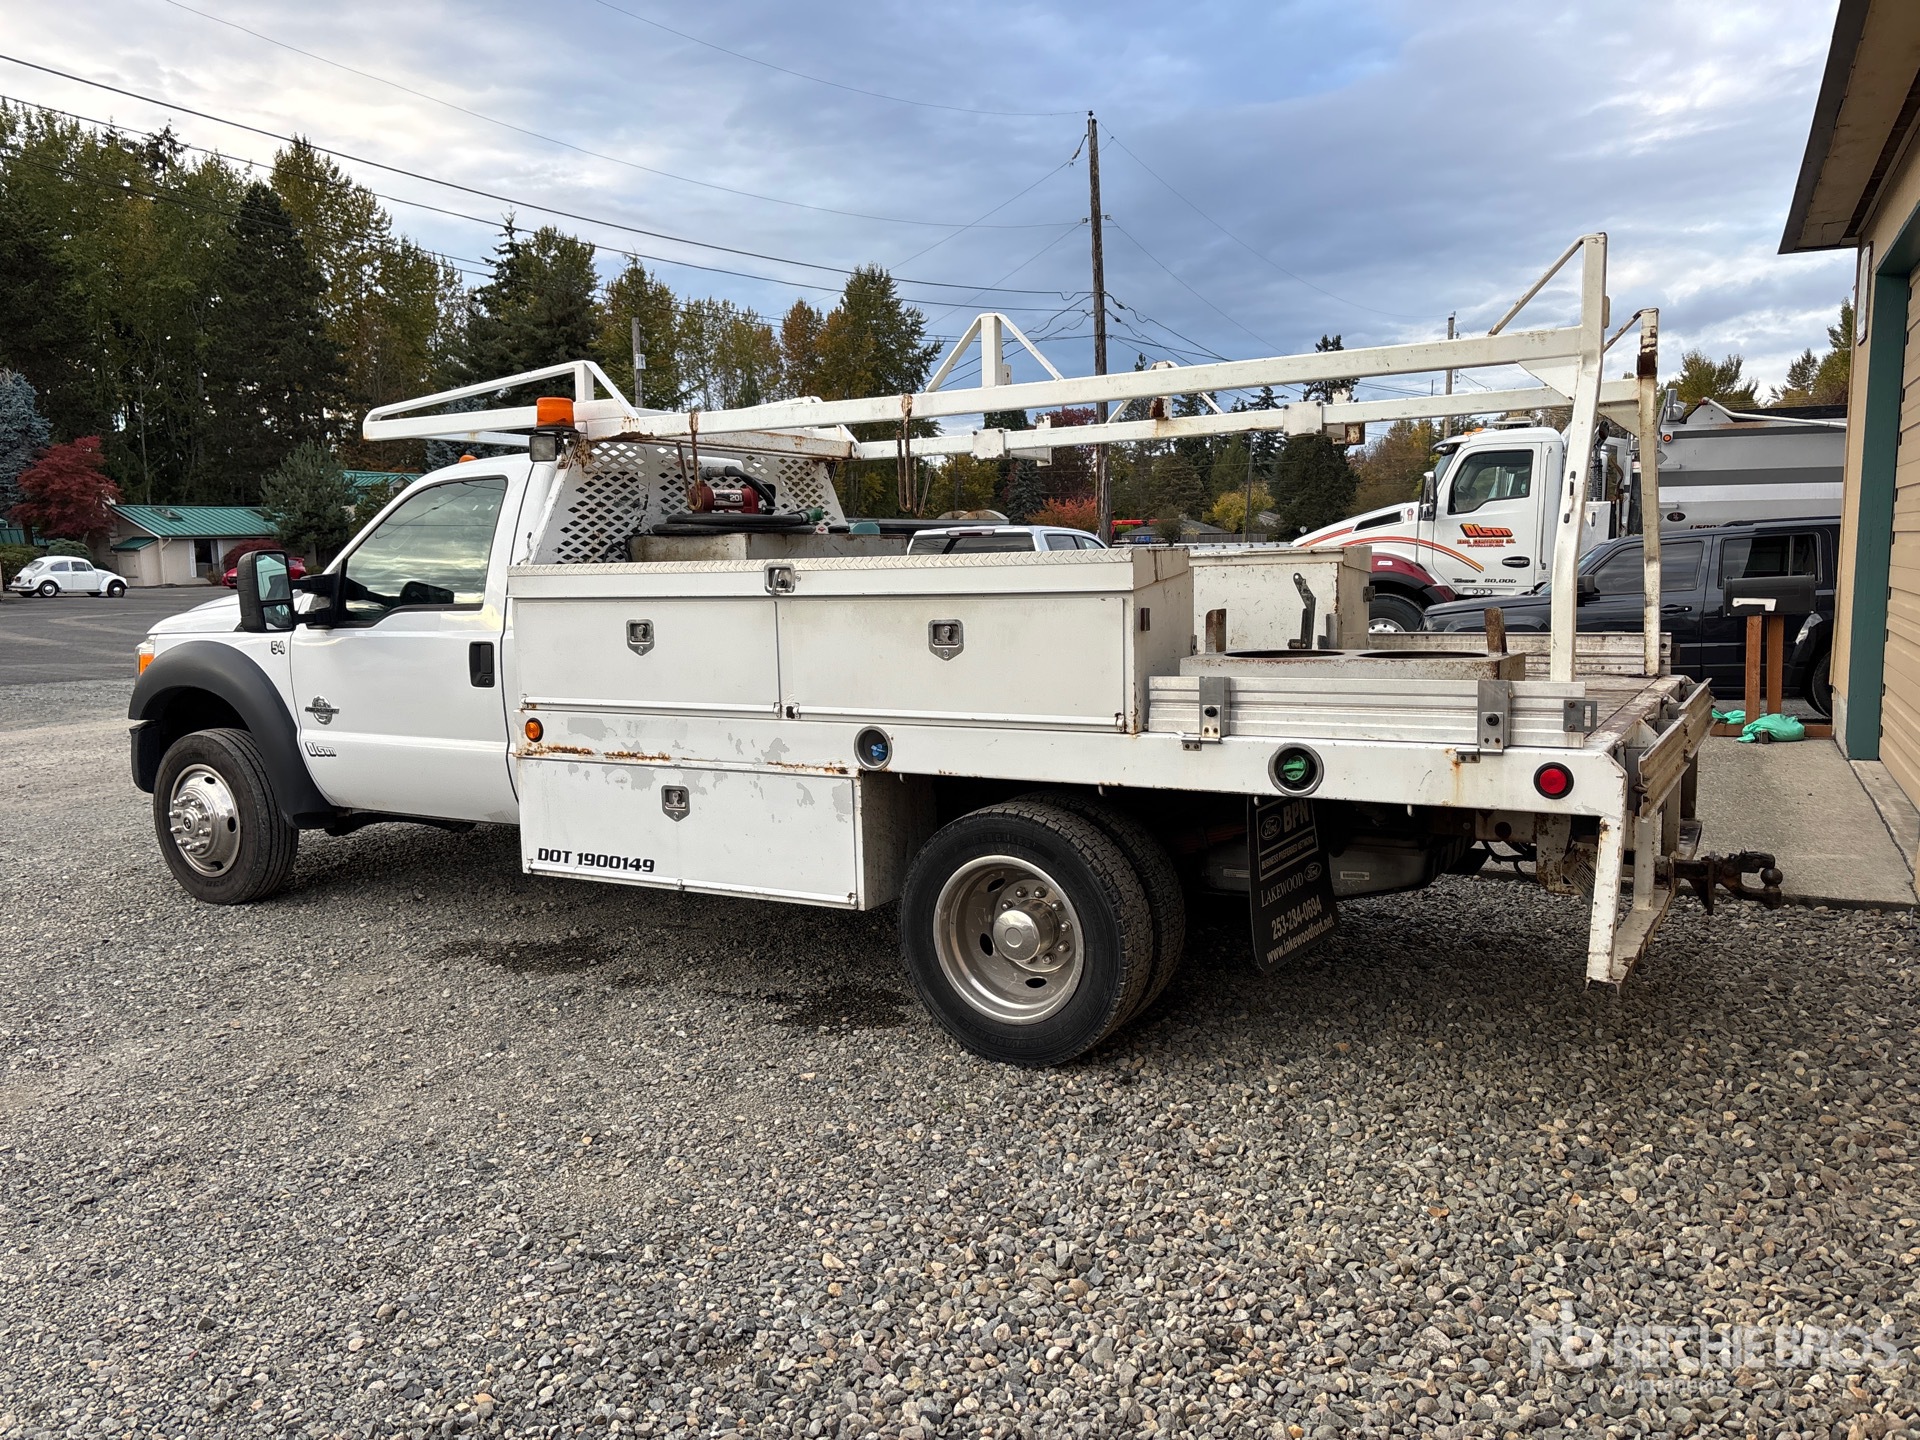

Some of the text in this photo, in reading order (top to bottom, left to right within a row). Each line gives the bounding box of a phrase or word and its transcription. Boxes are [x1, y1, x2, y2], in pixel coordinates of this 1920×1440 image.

[1459, 523, 1513, 538] Olson
[271, 641, 285, 655] 54
[305, 741, 337, 757] Olson
[1283, 799, 1310, 833] BPN
[538, 847, 655, 873] DOT 1900149
[1260, 872, 1304, 908] LAKEWOOD
[1271, 894, 1323, 941] 253-284-0694
[1266, 913, 1335, 964] www.lakewoodford.net
